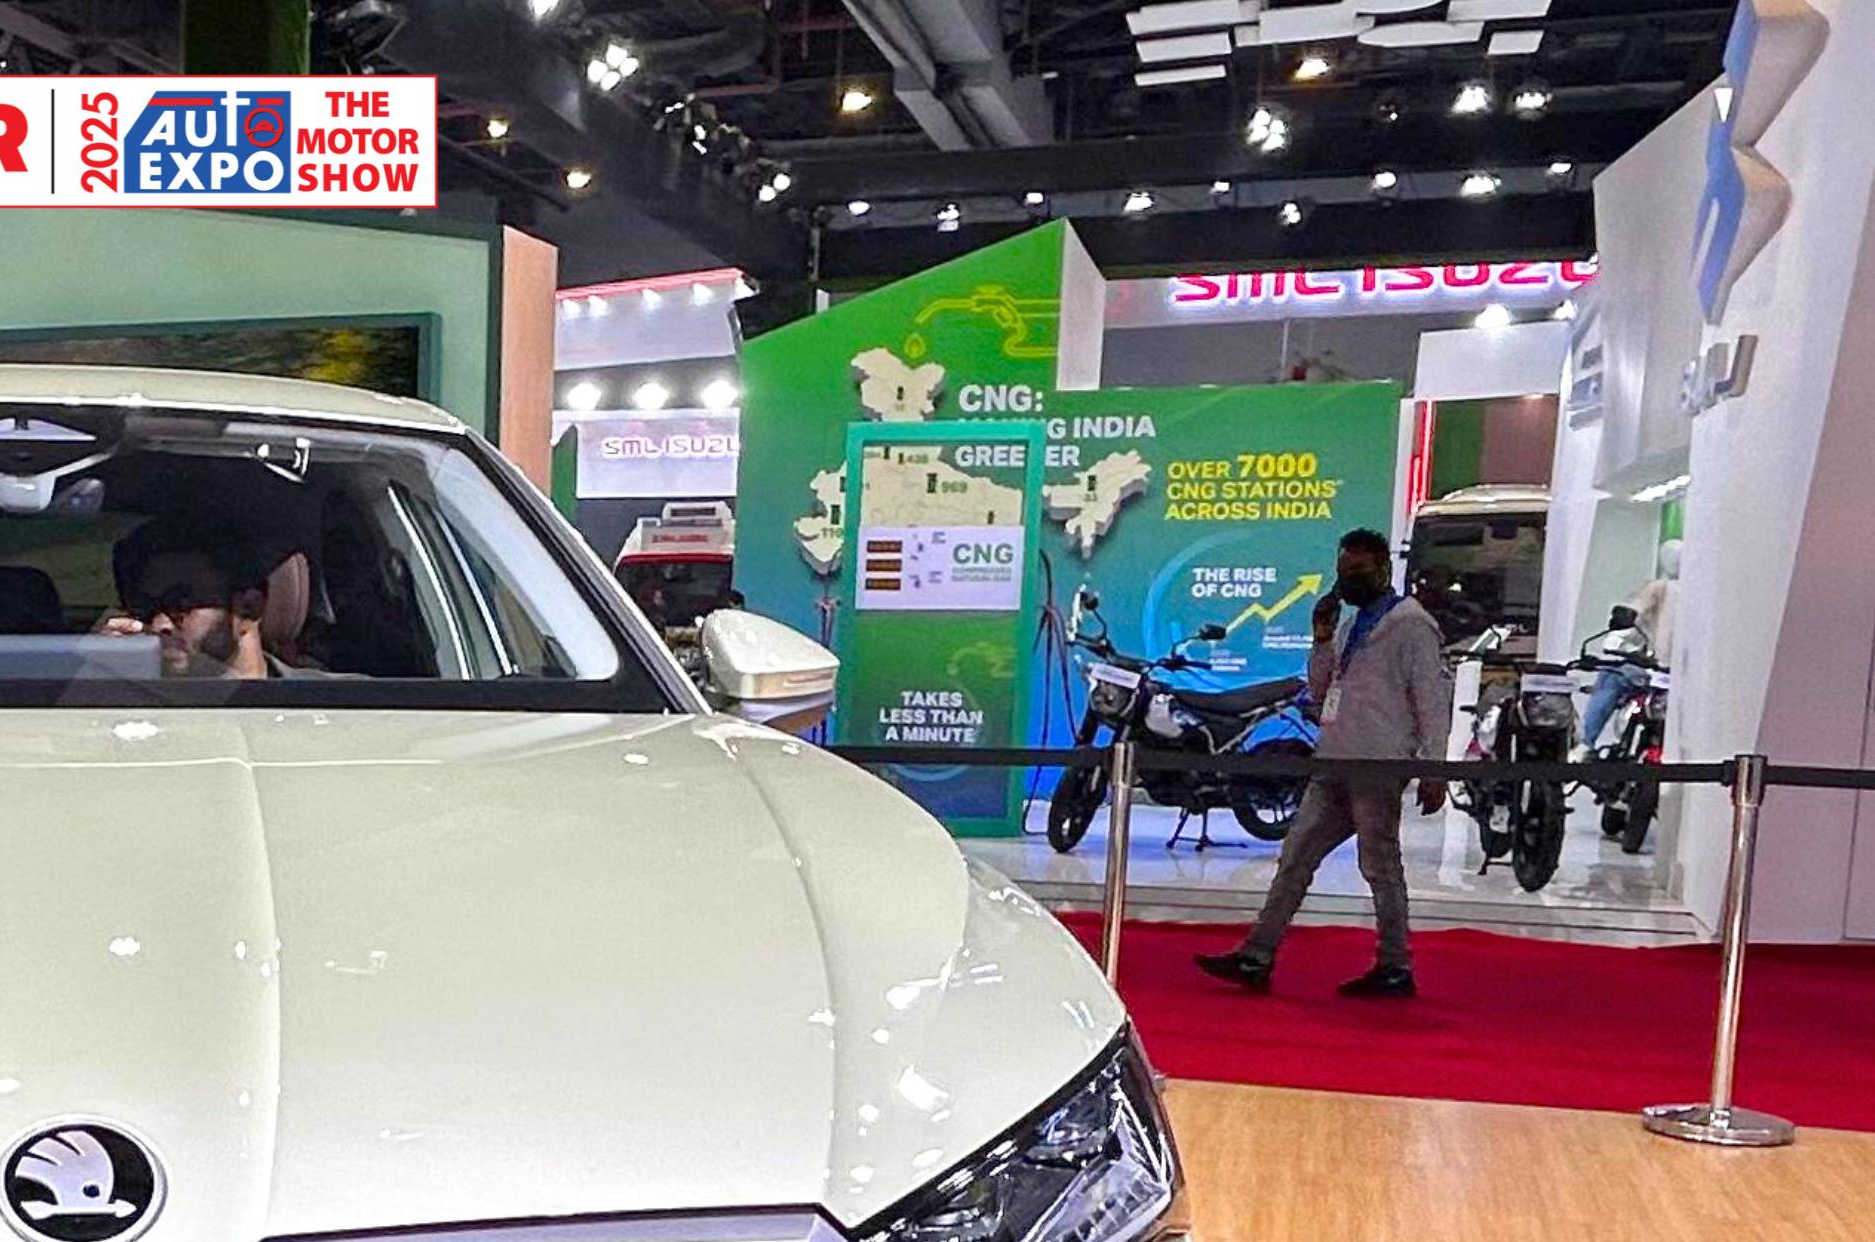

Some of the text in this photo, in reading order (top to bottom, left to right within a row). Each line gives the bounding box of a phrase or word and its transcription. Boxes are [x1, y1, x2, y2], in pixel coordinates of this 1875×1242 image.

[958, 384, 1044, 412] CNG:
[1073, 415, 1156, 438] INDIA
[955, 446, 1080, 467] GREEER
[1167, 453, 1317, 480] OVER 7000
[1166, 482, 1216, 499] CNG
[1165, 501, 1331, 520] ACROSS INDIA
[952, 543, 1013, 564] CNG
[1193, 567, 1277, 582] THE RISE
[1191, 583, 1262, 598] OF CNG
[901, 691, 963, 707] TAKES
[879, 708, 984, 725] LESS THAN
[886, 725, 975, 743] A MINUTE
